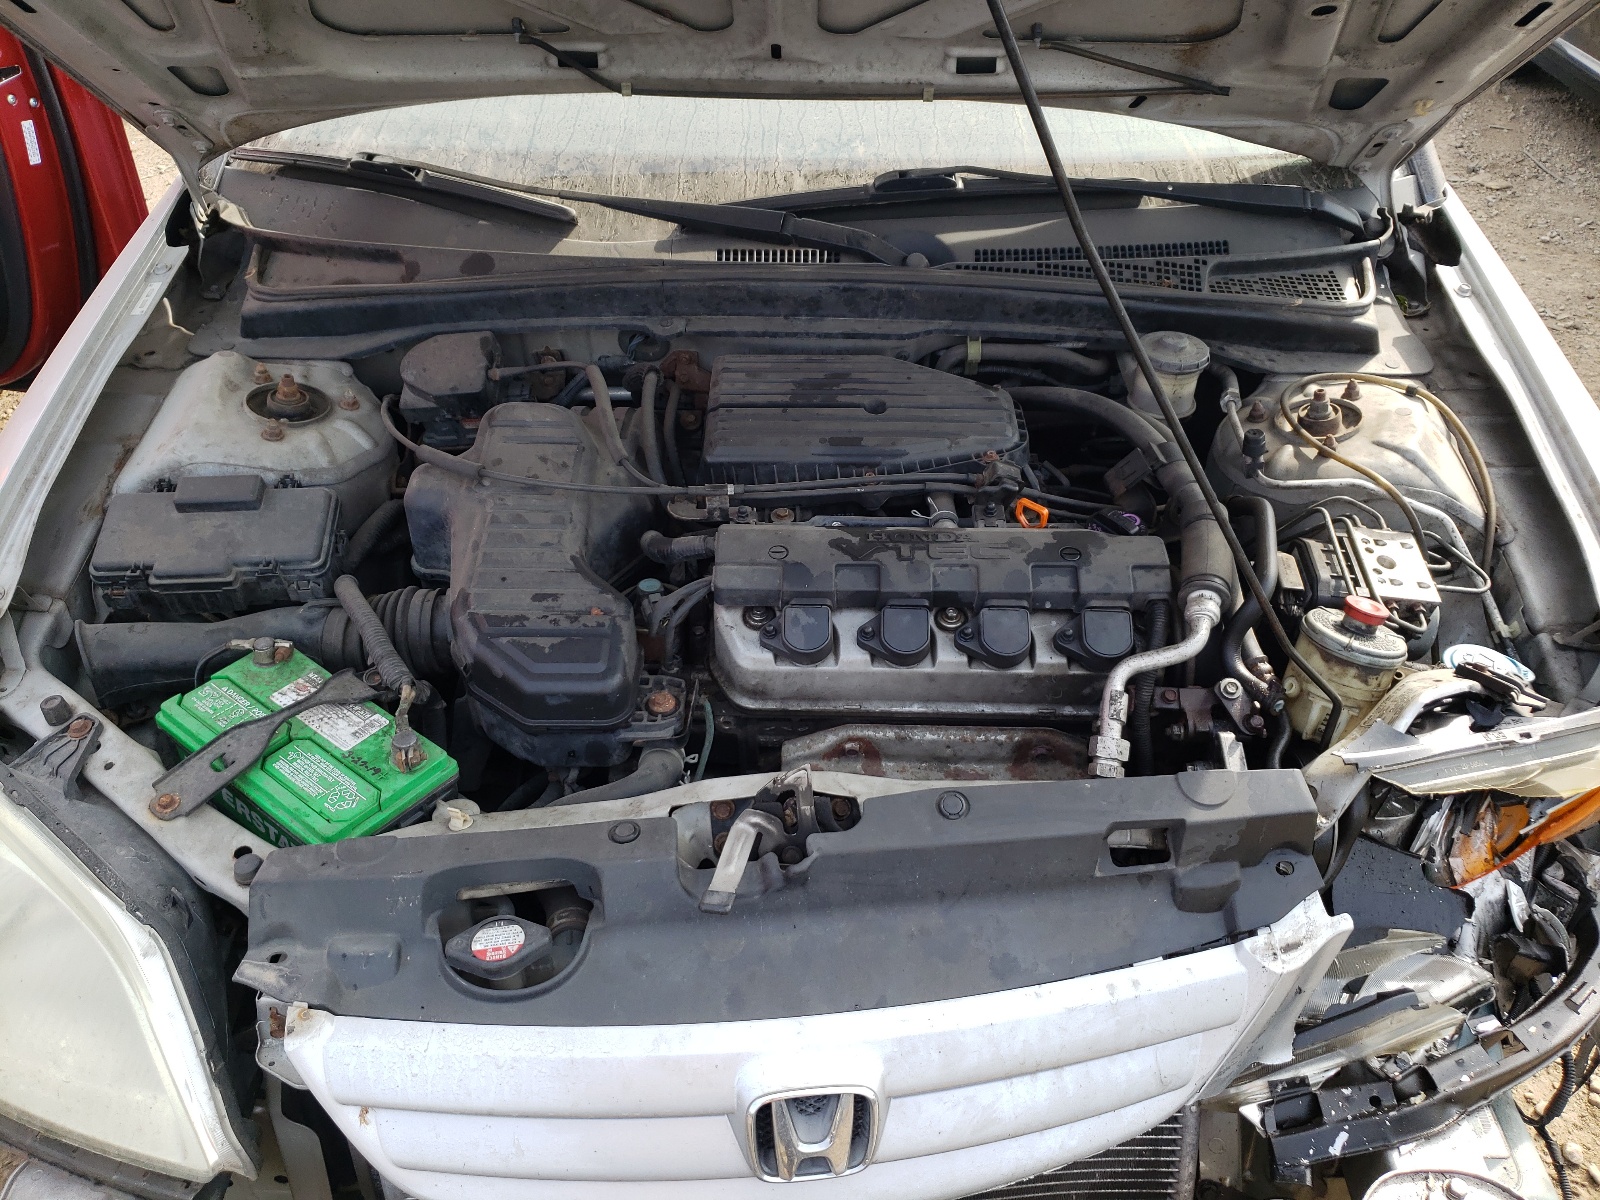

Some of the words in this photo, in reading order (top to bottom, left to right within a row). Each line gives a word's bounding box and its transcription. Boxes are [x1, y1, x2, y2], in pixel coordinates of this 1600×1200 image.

[866, 532, 979, 543] HONDA
[846, 543, 1010, 562] VTEC
[226, 689, 251, 708] DANGER
[221, 787, 296, 847] ERSTA
